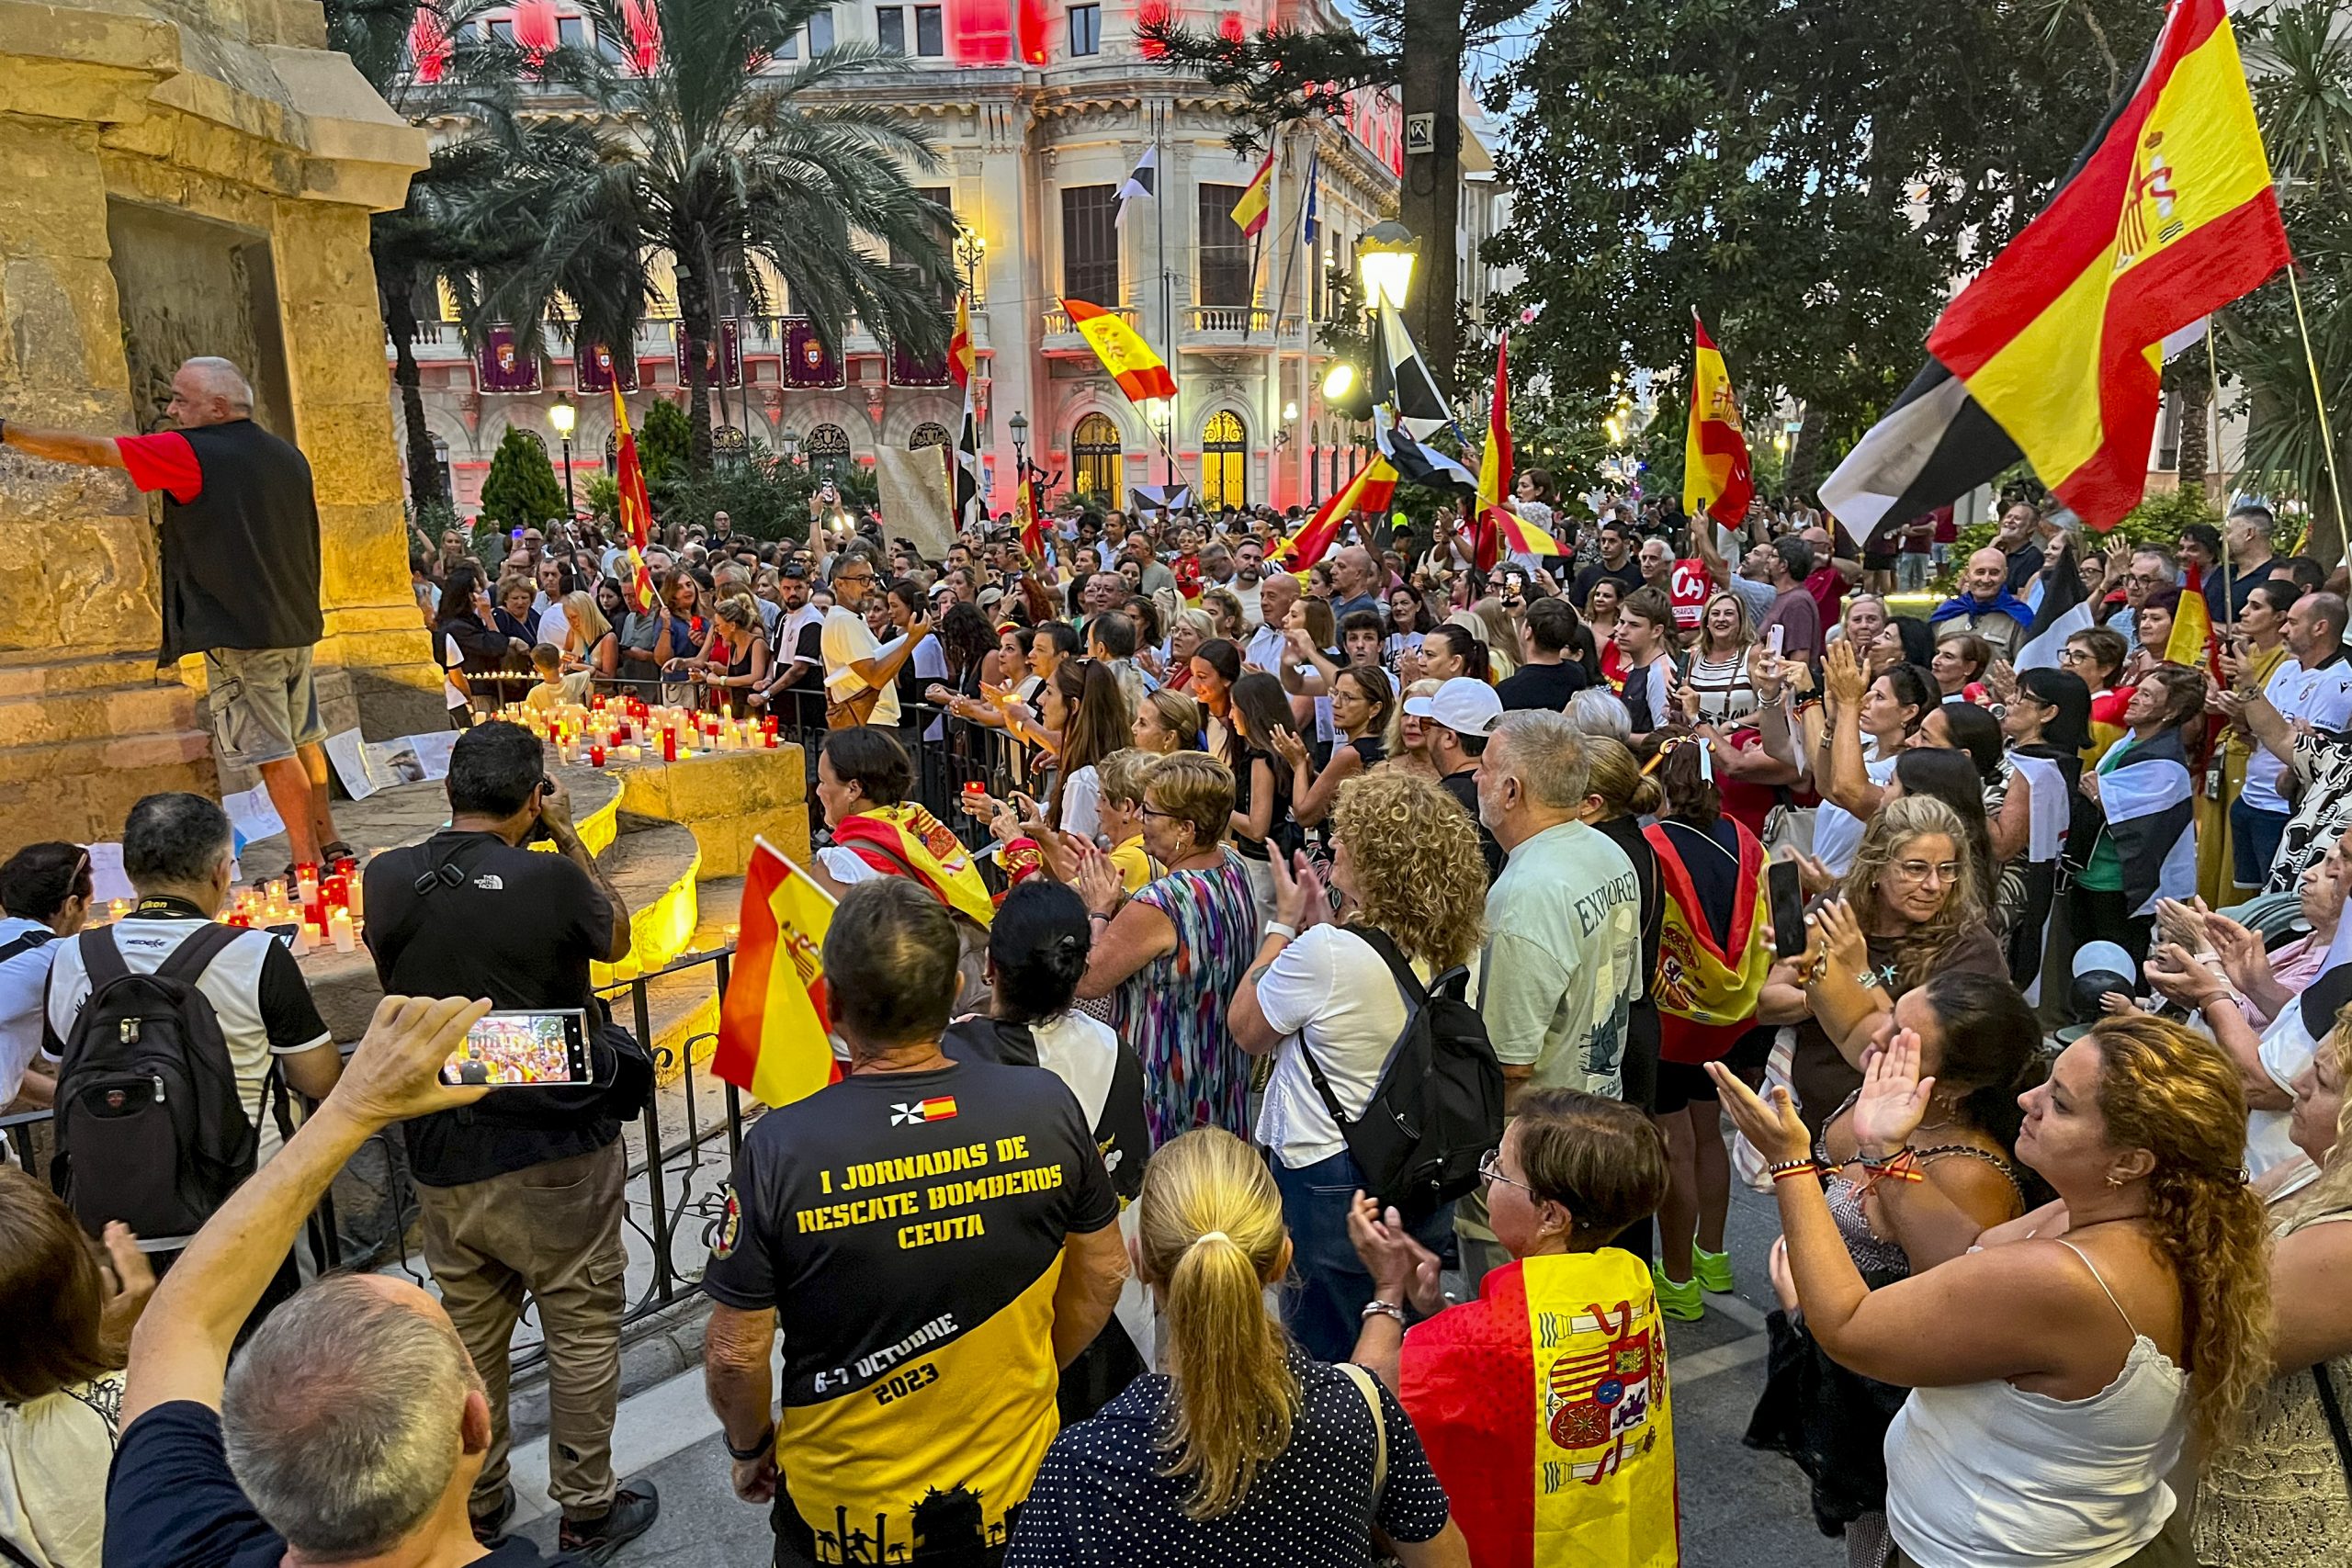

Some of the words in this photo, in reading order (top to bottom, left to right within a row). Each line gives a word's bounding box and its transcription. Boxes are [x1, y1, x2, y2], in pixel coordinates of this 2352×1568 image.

[140, 901, 167, 910] Nikon
[820, 1170, 832, 1194] I
[841, 1143, 989, 1191] JORNADAS
[995, 1135, 1030, 1163] DE
[796, 1190, 920, 1234] RESCATE
[927, 1164, 1063, 1211] BOMBEROS
[898, 1213, 985, 1250] CEUTA
[814, 1368, 850, 1393] 6-7
[854, 1313, 959, 1378] OCTUBRE
[872, 1362, 940, 1405] 2023
